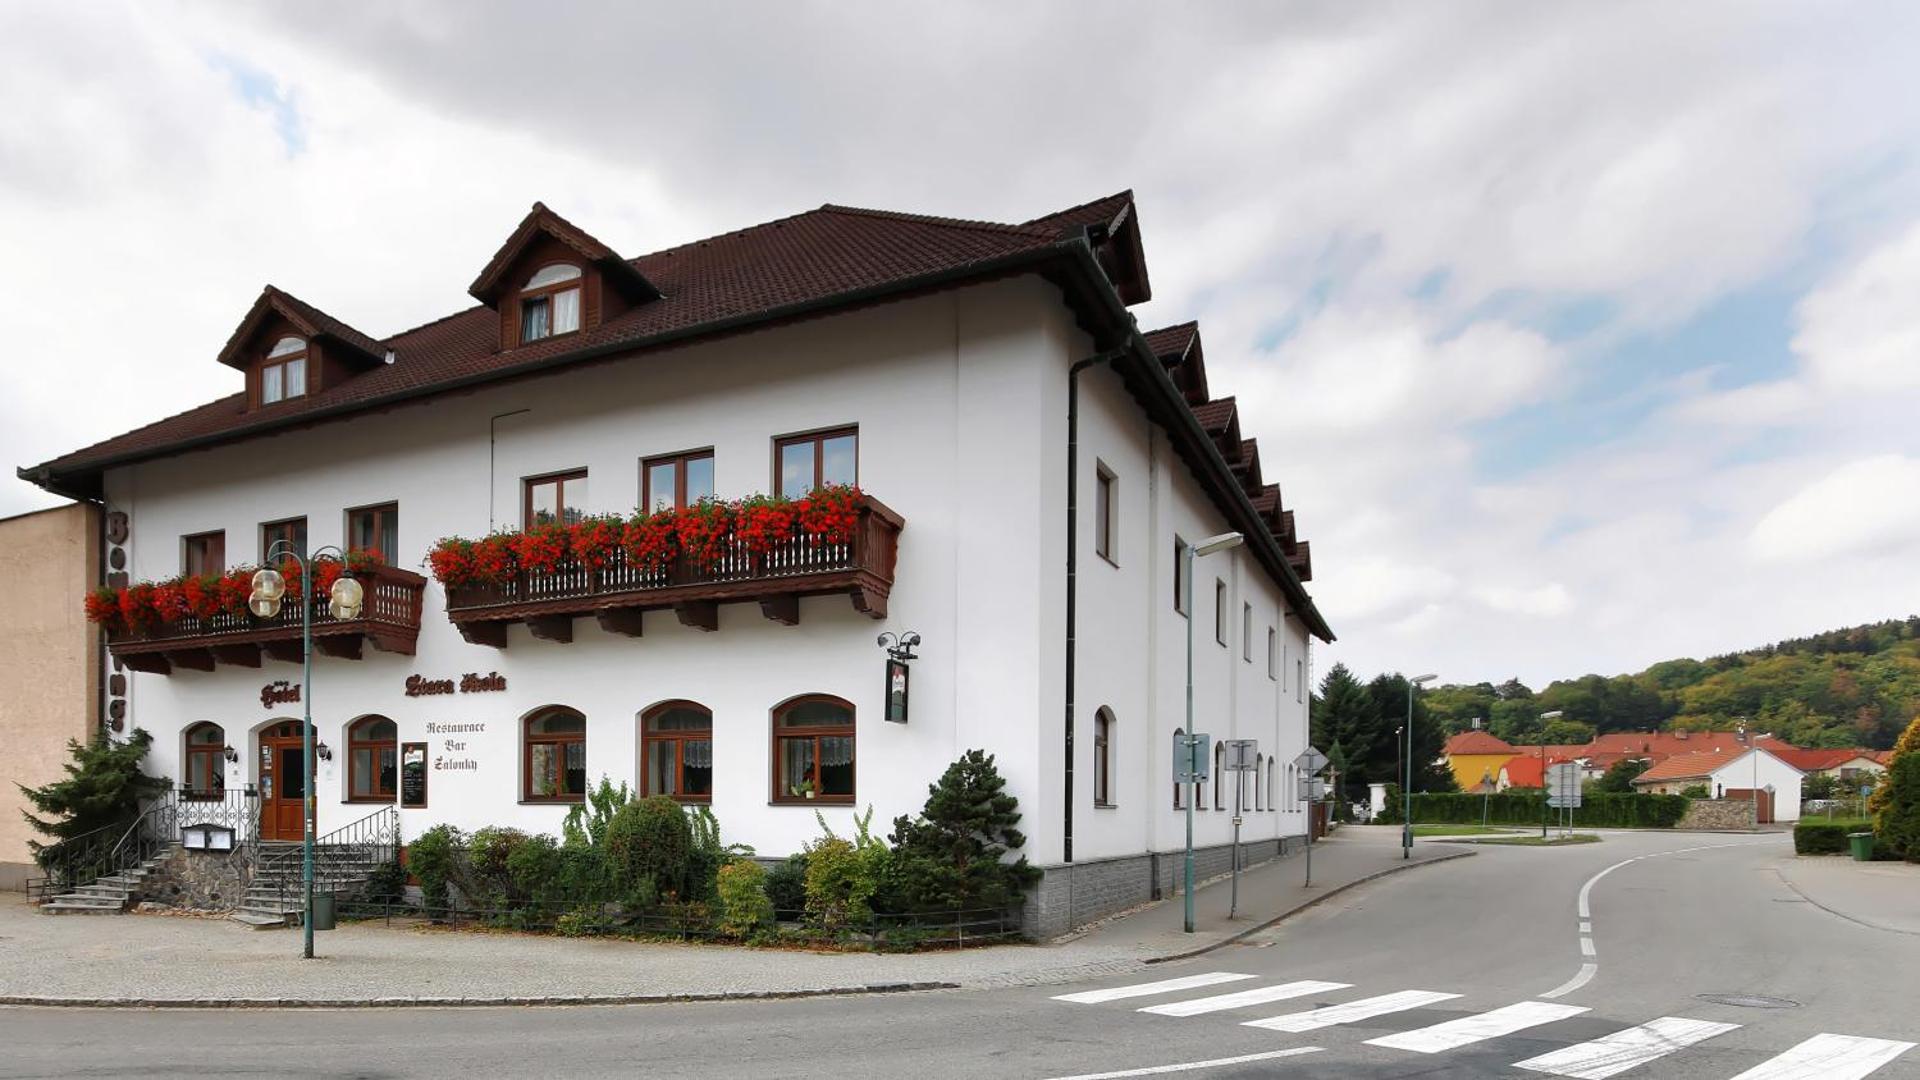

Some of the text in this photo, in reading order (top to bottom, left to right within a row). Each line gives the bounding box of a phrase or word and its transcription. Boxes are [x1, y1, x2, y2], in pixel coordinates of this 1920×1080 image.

[260, 684, 301, 709] Hotel
[426, 722, 485, 733] Restaurace
[444, 739, 466, 751] Bar
